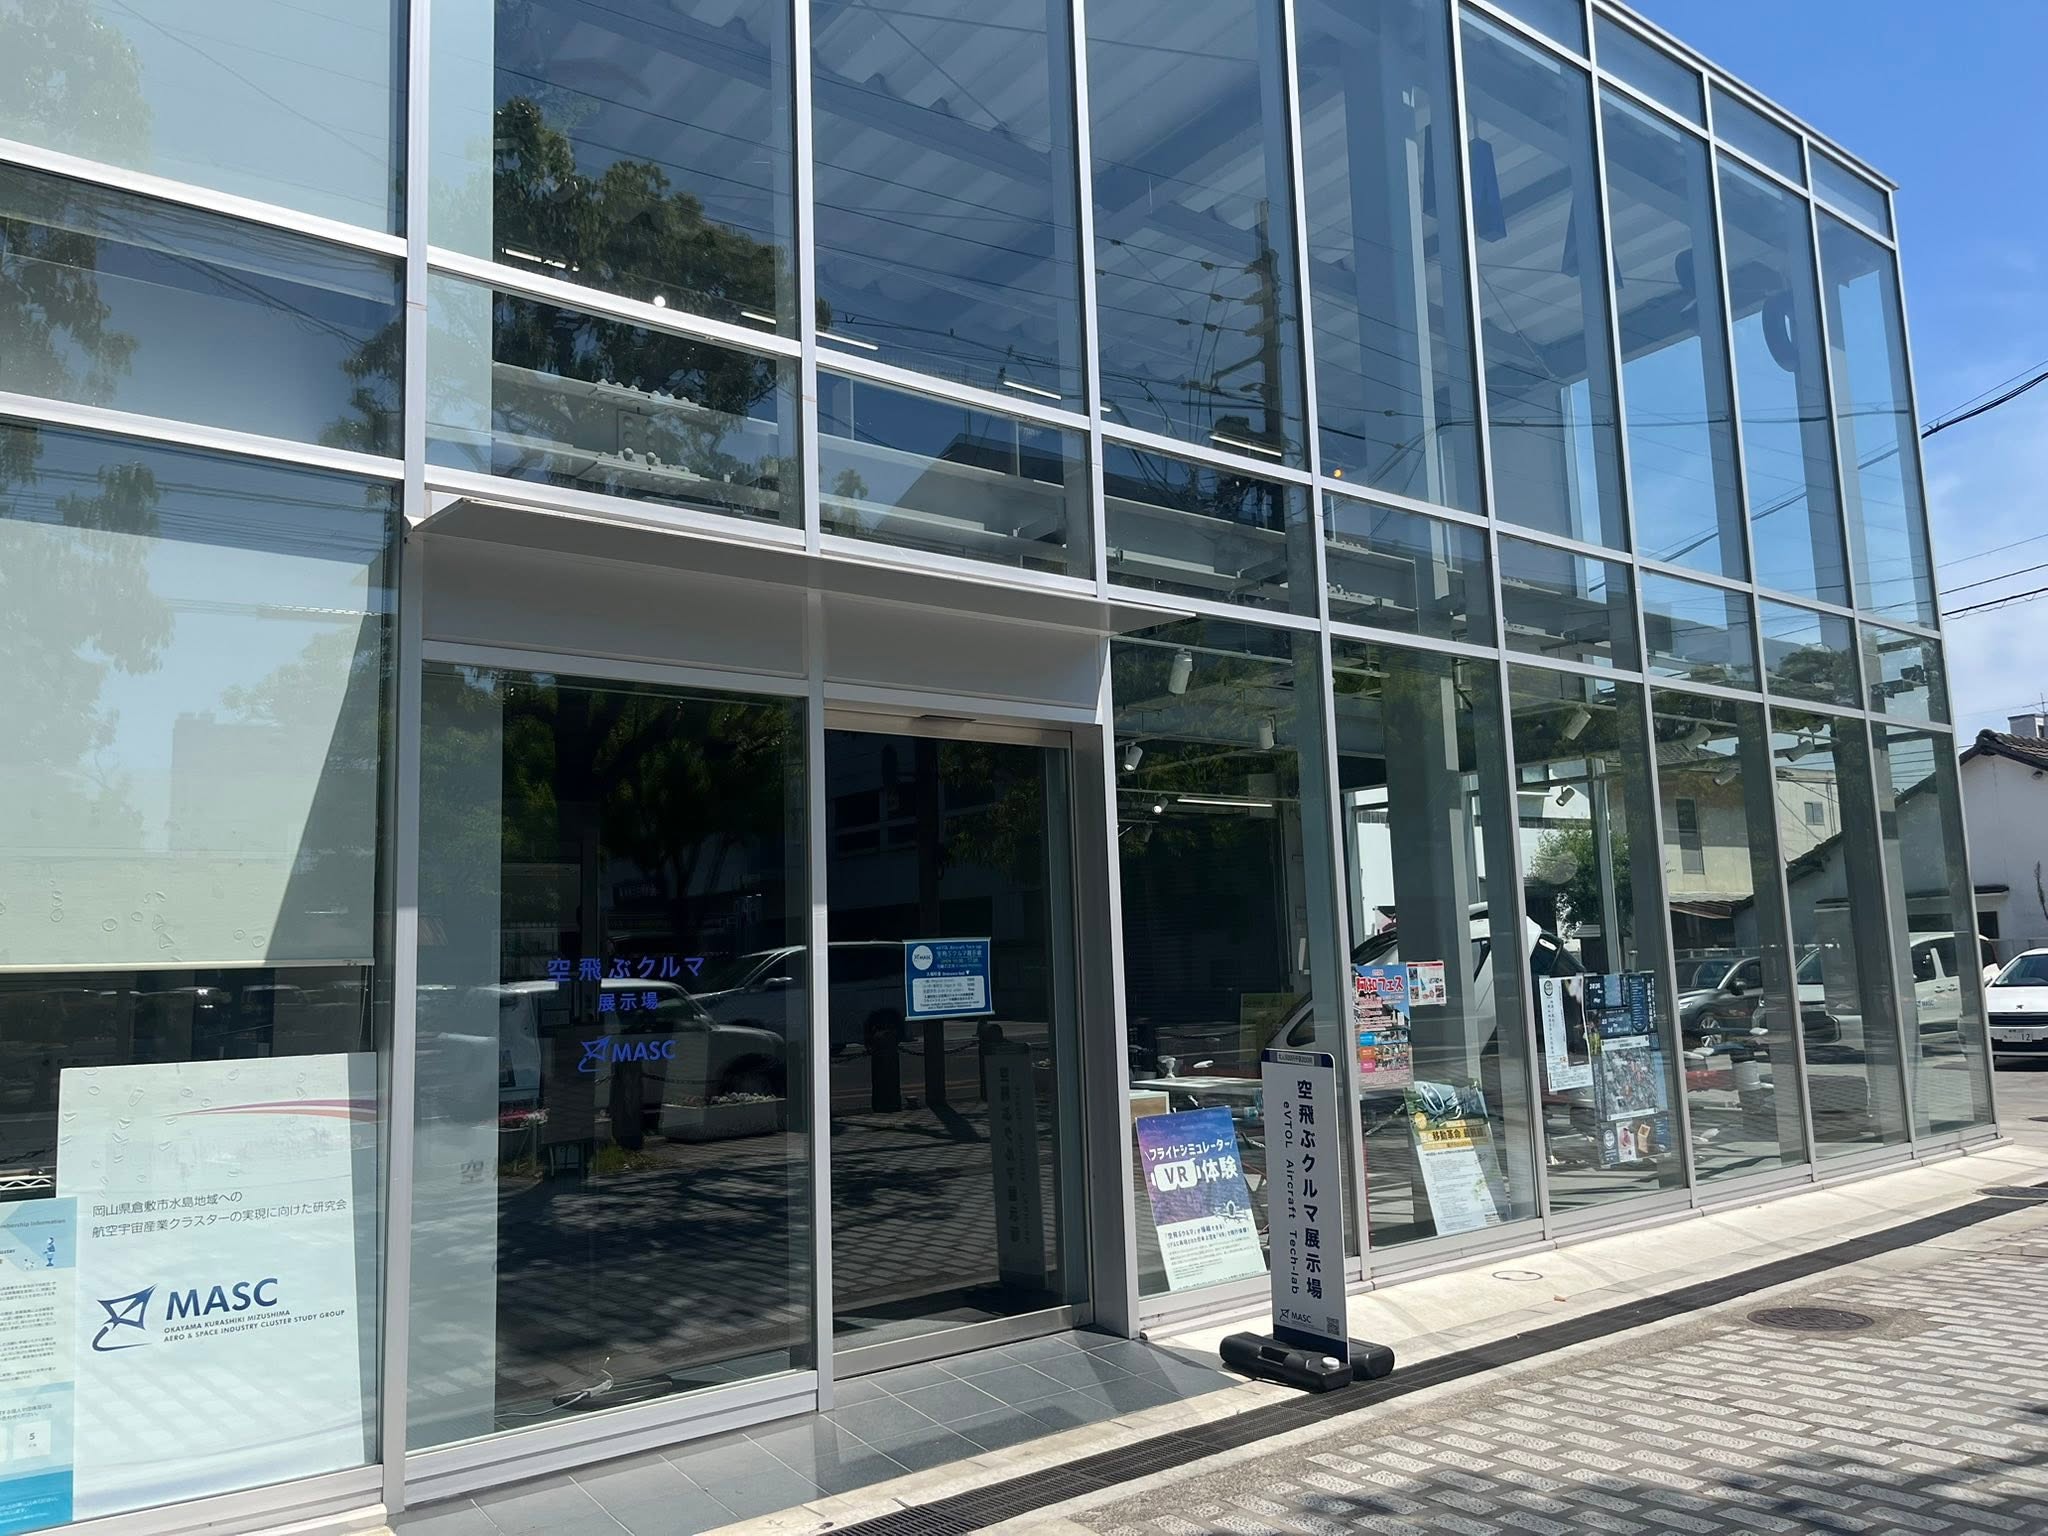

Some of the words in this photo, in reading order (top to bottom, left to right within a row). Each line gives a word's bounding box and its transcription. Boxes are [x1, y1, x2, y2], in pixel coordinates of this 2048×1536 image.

[547, 955, 705, 982] 空飛ぶクルマ
[598, 991, 660, 1013] 展示場
[611, 1039, 679, 1063] MASC
[1283, 1101, 1293, 1148] eVTOL
[1149, 1138, 1231, 1162] フライトシミュレーター
[1163, 1165, 1189, 1186] VR
[1201, 1156, 1240, 1184] 体験
[1285, 1158, 1297, 1220] Aircraft
[1296, 1079, 1323, 1300] 空飛ぶクルマ展示場
[91, 1198, 348, 1238] 航空宇宙産業クラスターの実現に向けた研究会
[92, 1191, 243, 1218] 岡山県倉敷市水島地域への
[1288, 1230, 1300, 1295] Tech-lab
[165, 1278, 278, 1321] MASC
[164, 1323, 201, 1334] OKAYAMA
[204, 1317, 245, 1328] KURASHIKI
[247, 1309, 291, 1322] MIZUSHIMA
[164, 1333, 185, 1343] AERO
[187, 1331, 194, 1339] &
[195, 1328, 219, 1338] SPACE
[221, 1322, 258, 1335] INDUSTRY
[260, 1317, 292, 1329] CLUSTER
[294, 1313, 318, 1324] STUDY
[319, 1309, 346, 1320] GROUP
[1291, 1311, 1312, 1324] MASC
[28, 1432, 36, 1441] 5
